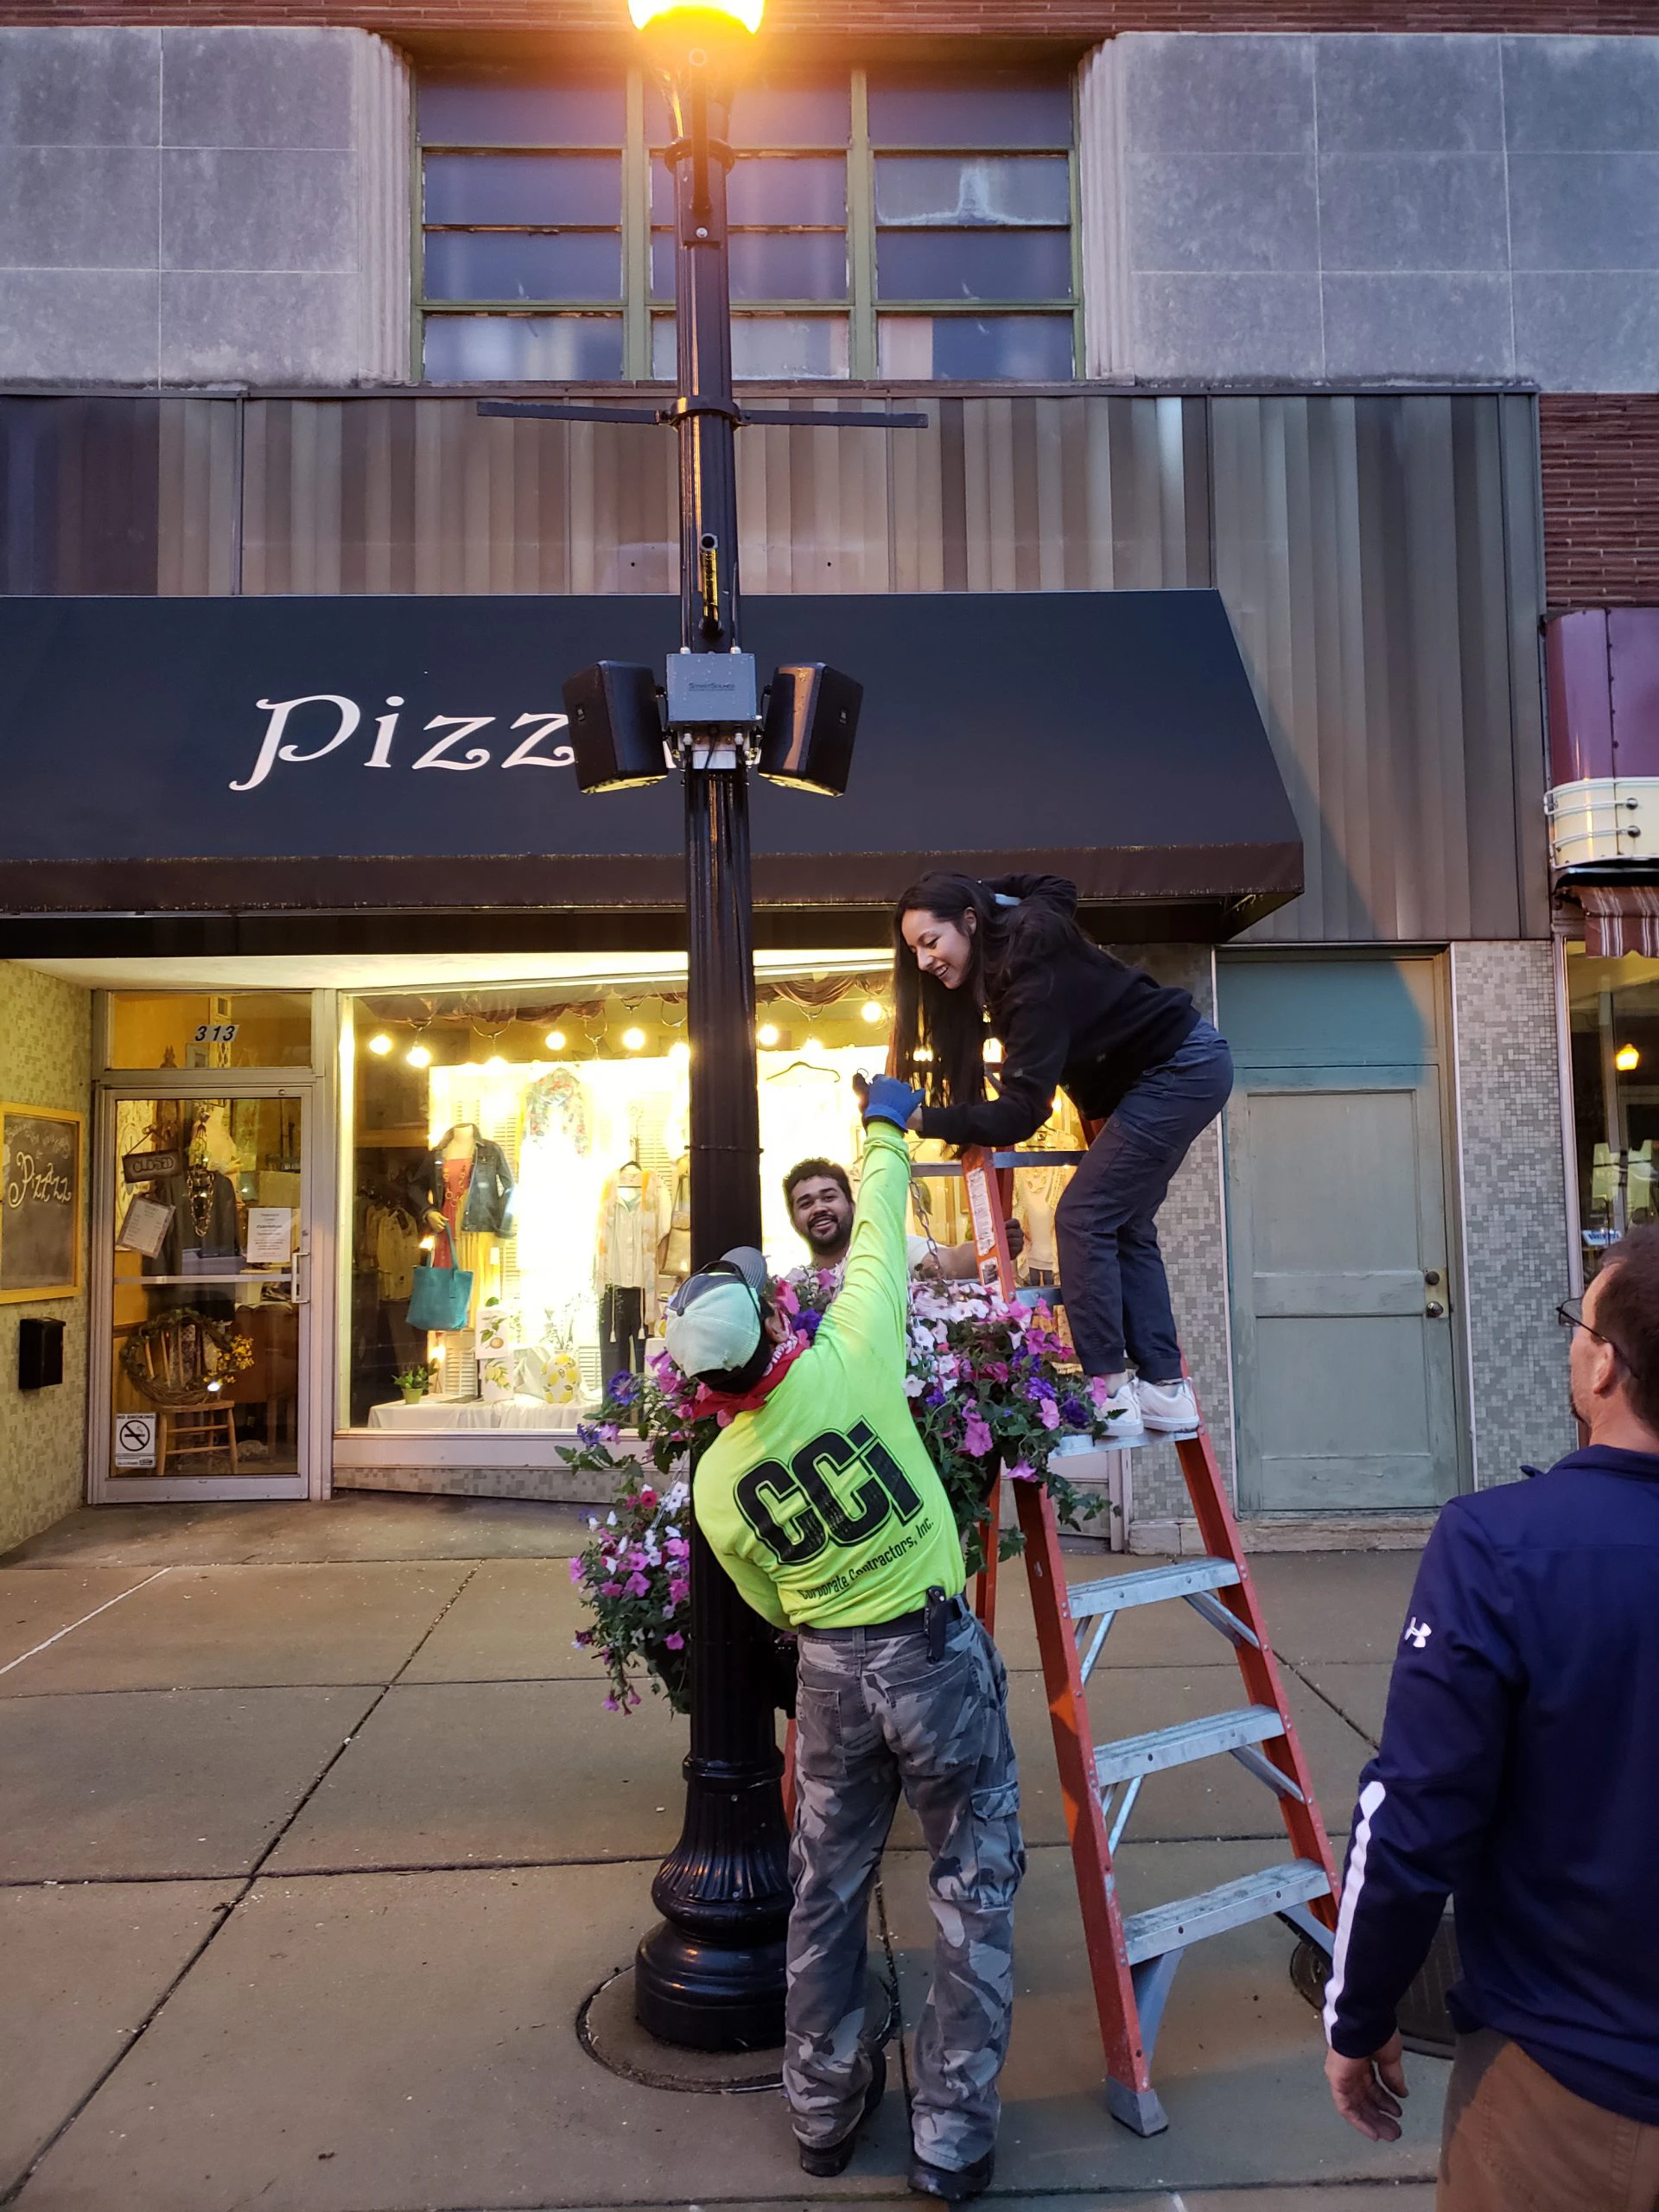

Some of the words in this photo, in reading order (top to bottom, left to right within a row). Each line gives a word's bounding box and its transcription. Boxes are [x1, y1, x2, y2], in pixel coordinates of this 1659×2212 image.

[229, 695, 677, 791] Pizz
[195, 1026, 235, 1041] 313
[132, 1157, 174, 1173] CLOSED
[798, 1575, 849, 1600] Corporate
[915, 1517, 934, 1539] Inc.
